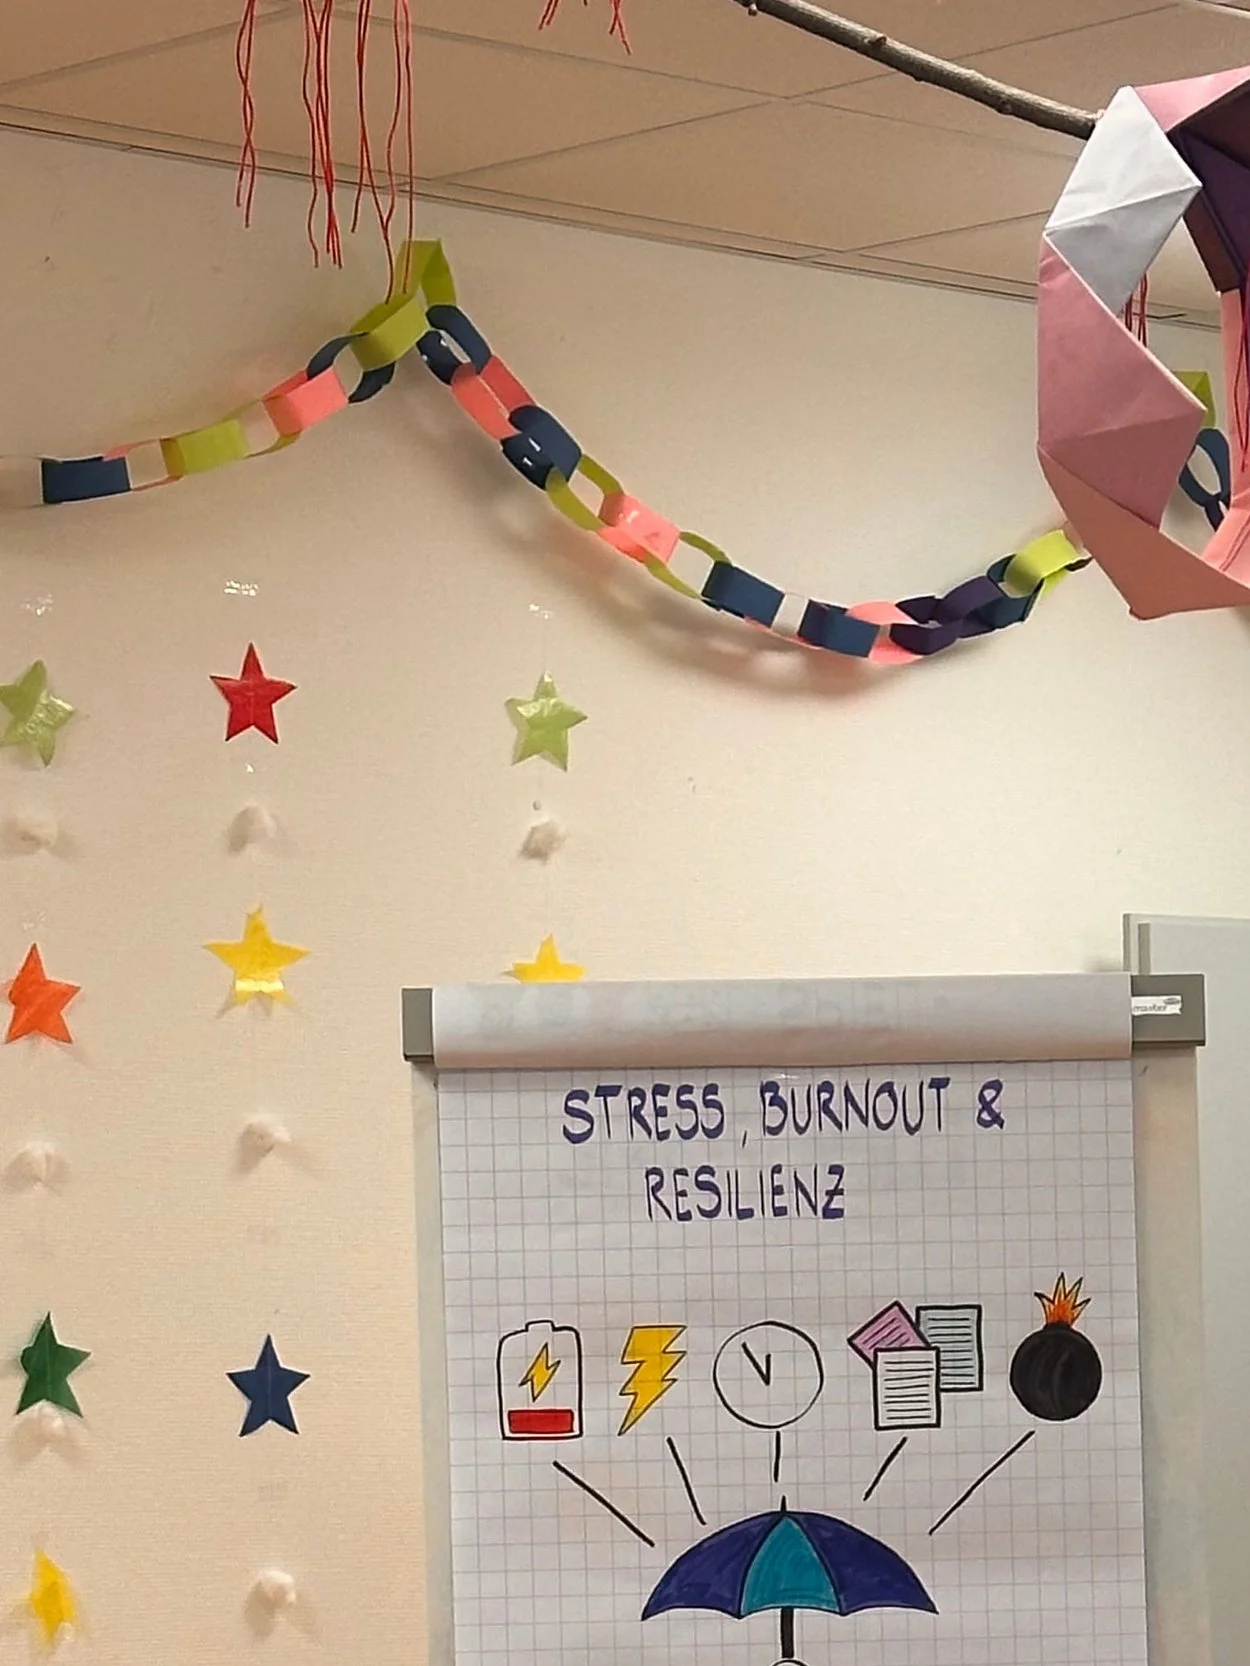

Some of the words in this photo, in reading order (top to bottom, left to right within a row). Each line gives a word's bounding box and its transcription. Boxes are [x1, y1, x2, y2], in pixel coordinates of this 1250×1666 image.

[760, 1077, 951, 1137] BURNOUT
[975, 1079, 1005, 1131] &
[645, 1164, 845, 1222] RESILIENZ
